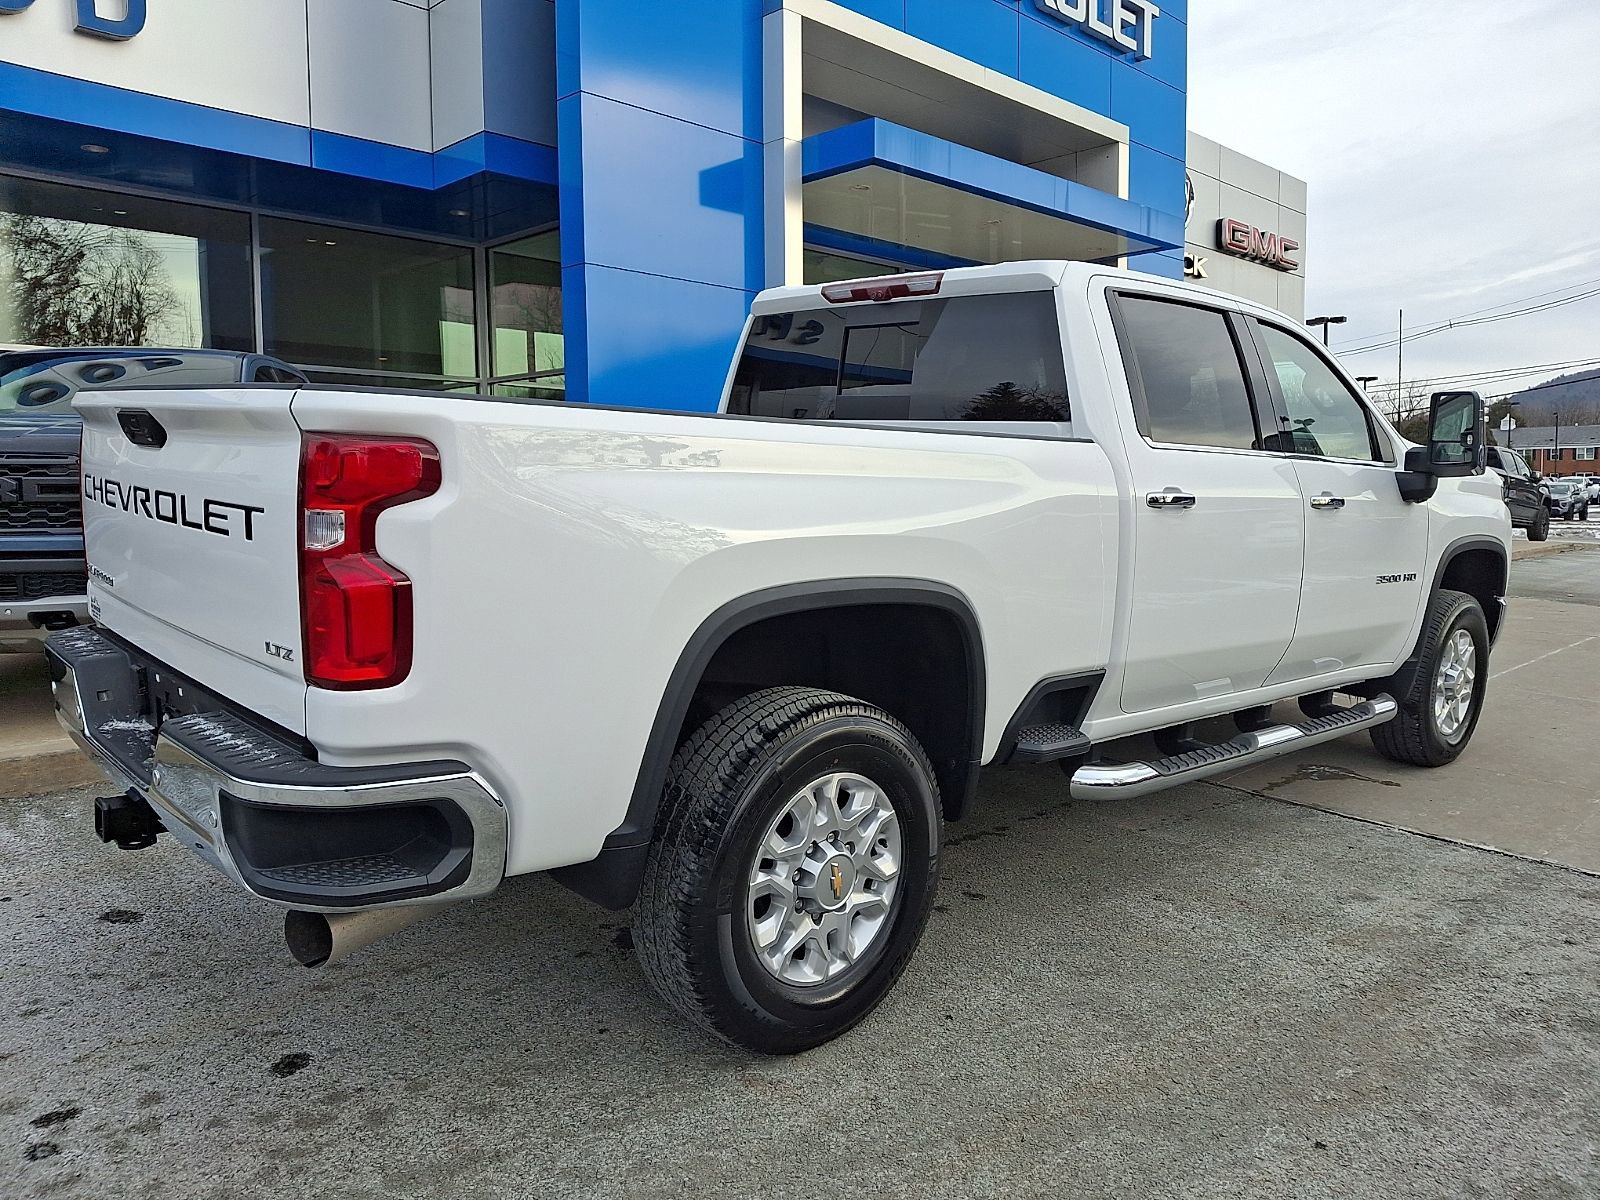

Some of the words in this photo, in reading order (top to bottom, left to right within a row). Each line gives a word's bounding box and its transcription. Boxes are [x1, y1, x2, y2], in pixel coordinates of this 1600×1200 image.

[1216, 218, 1299, 270] GMC
[84, 473, 265, 541] CHEVROLET
[1403, 573, 1416, 582] HD
[264, 640, 294, 662] LTZ
